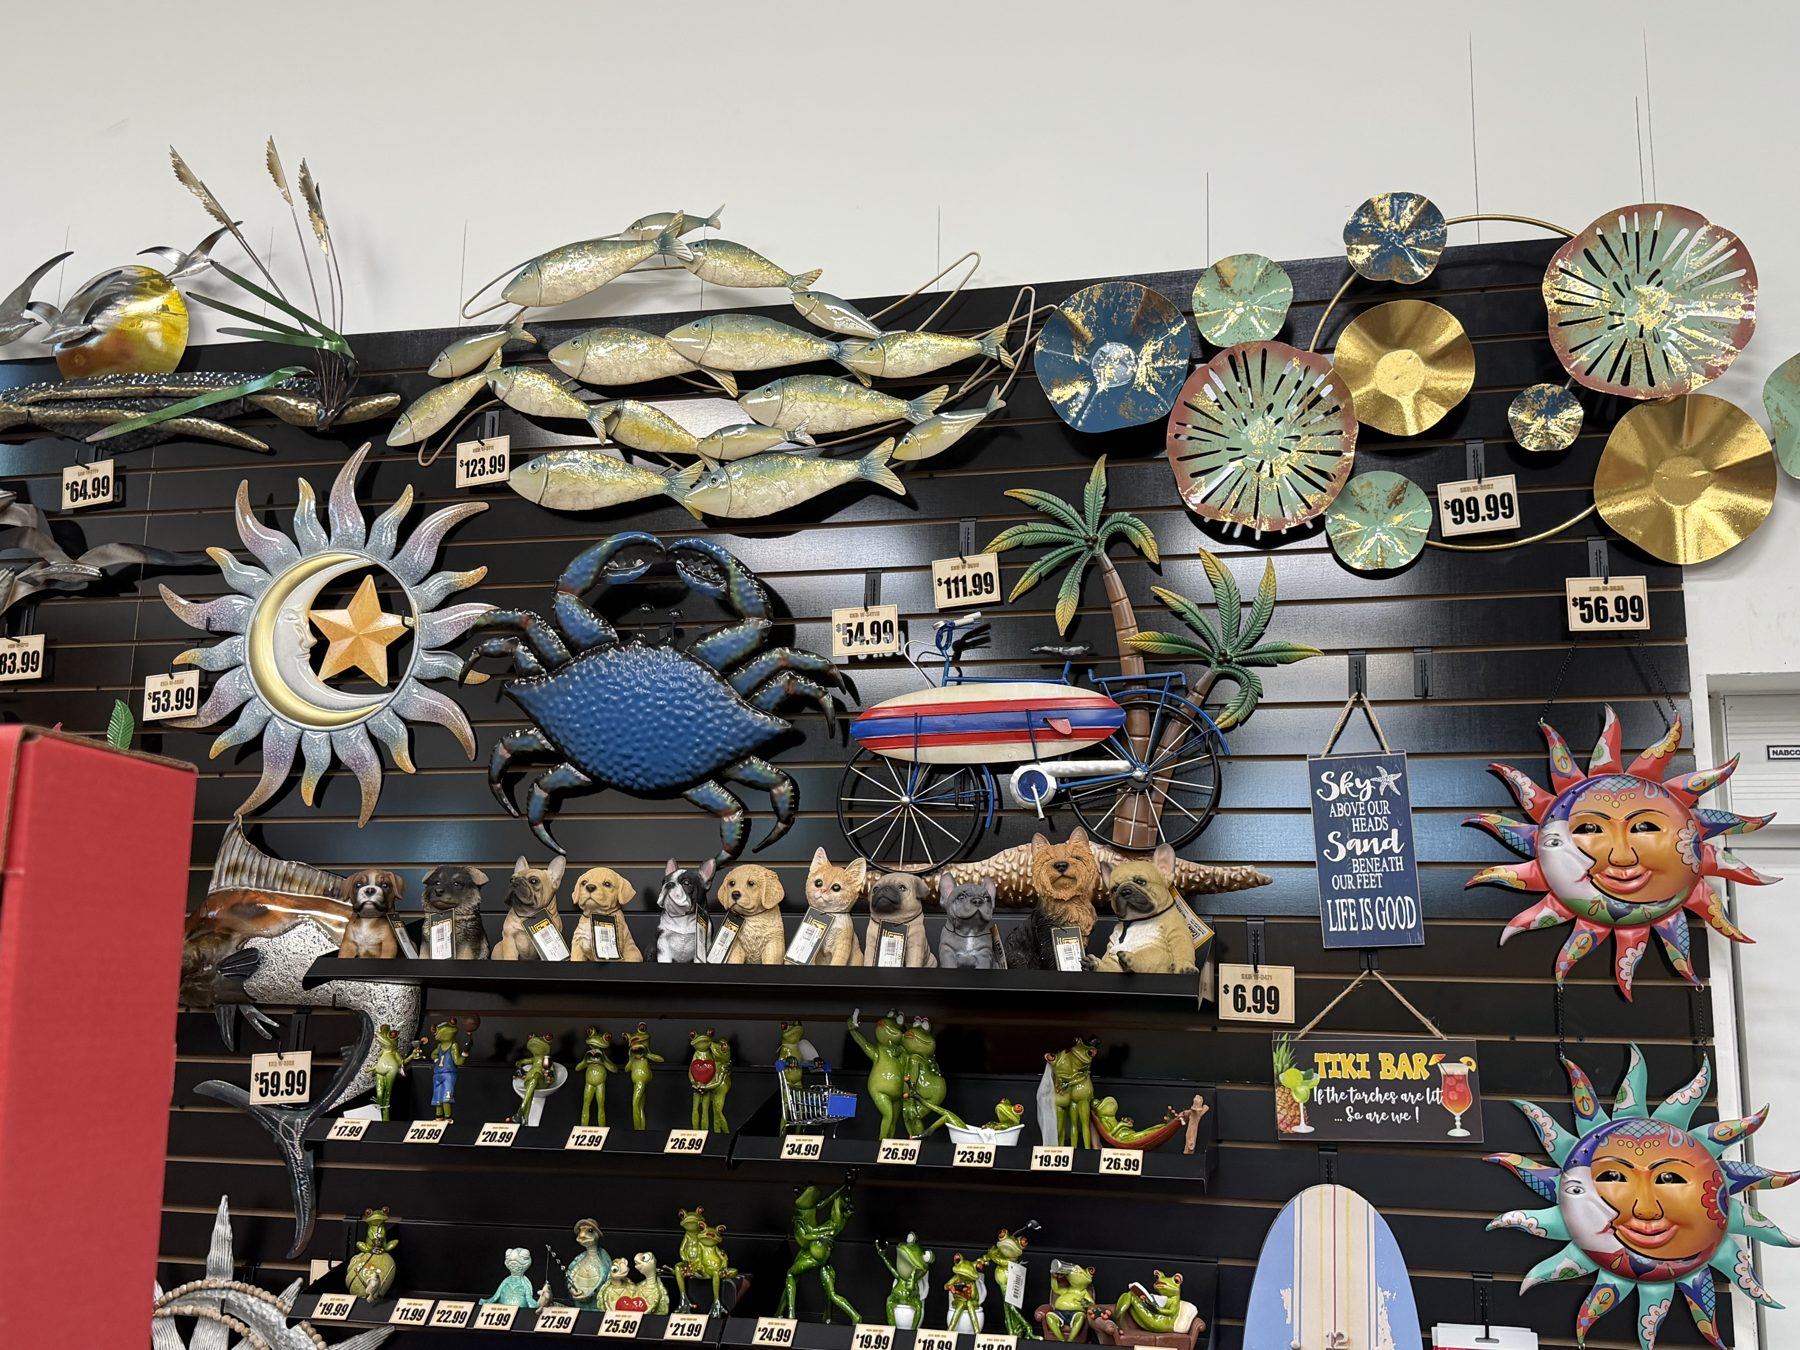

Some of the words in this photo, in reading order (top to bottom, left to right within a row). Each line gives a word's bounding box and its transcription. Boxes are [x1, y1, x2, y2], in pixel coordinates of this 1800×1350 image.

[459, 454, 506, 478] $123.99
[65, 475, 110, 502] $64.99
[1443, 492, 1514, 525] $99.99
[937, 572, 994, 599] $111.99
[1571, 595, 1644, 623] $56.99
[835, 620, 894, 647] $54.99
[147, 687, 195, 714] $53.99
[1316, 771, 1376, 801] Sky
[1329, 802, 1365, 818] ABOVE
[1368, 800, 1391, 815] OUR
[1351, 817, 1389, 833] HEADS
[1323, 828, 1405, 862] Sand
[1352, 856, 1405, 873] BENEATH
[1331, 874, 1355, 890] OUR
[1356, 873, 1383, 888] FEET
[1327, 898, 1359, 932] LIFE
[1359, 898, 1374, 931] IS
[1375, 895, 1417, 931] GOOD
[1223, 984, 1280, 1015] $6.99
[1314, 1052, 1371, 1080] TIKI
[1378, 1052, 1431, 1080] BAR
[254, 1069, 307, 1098] $59.99
[1313, 1087, 1325, 1105] If
[1324, 1086, 1348, 1104] the
[1347, 1086, 1398, 1105] torches
[1400, 1093, 1424, 1105] are
[1426, 1087, 1444, 1105] lit
[1345, 1106, 1363, 1123] So
[1365, 1111, 1390, 1124] are
[1391, 1111, 1411, 1124] we
[333, 1125, 362, 1137] $17.99
[410, 1128, 441, 1140] $20.99
[482, 1131, 513, 1143] $20.99
[572, 1135, 601, 1147] $12.99
[670, 1138, 703, 1150] $26.99
[786, 1143, 819, 1156] $34.99
[882, 1147, 916, 1161] $26.99
[957, 1150, 992, 1164] $23.99
[1035, 1154, 1069, 1168] $19.99
[1103, 1158, 1140, 1172] $26.99
[319, 1302, 349, 1316] $19.99
[396, 1307, 426, 1322] $11.99
[437, 1309, 468, 1324] $22.99
[481, 1312, 511, 1326] $11.99
[541, 1315, 572, 1329] $27.99
[604, 1319, 638, 1334] $25.99
[670, 1322, 702, 1337] $21.99
[758, 1327, 791, 1342] $24.99
[856, 1333, 890, 1350] $19.99
[917, 1338, 953, 1350] $1899
